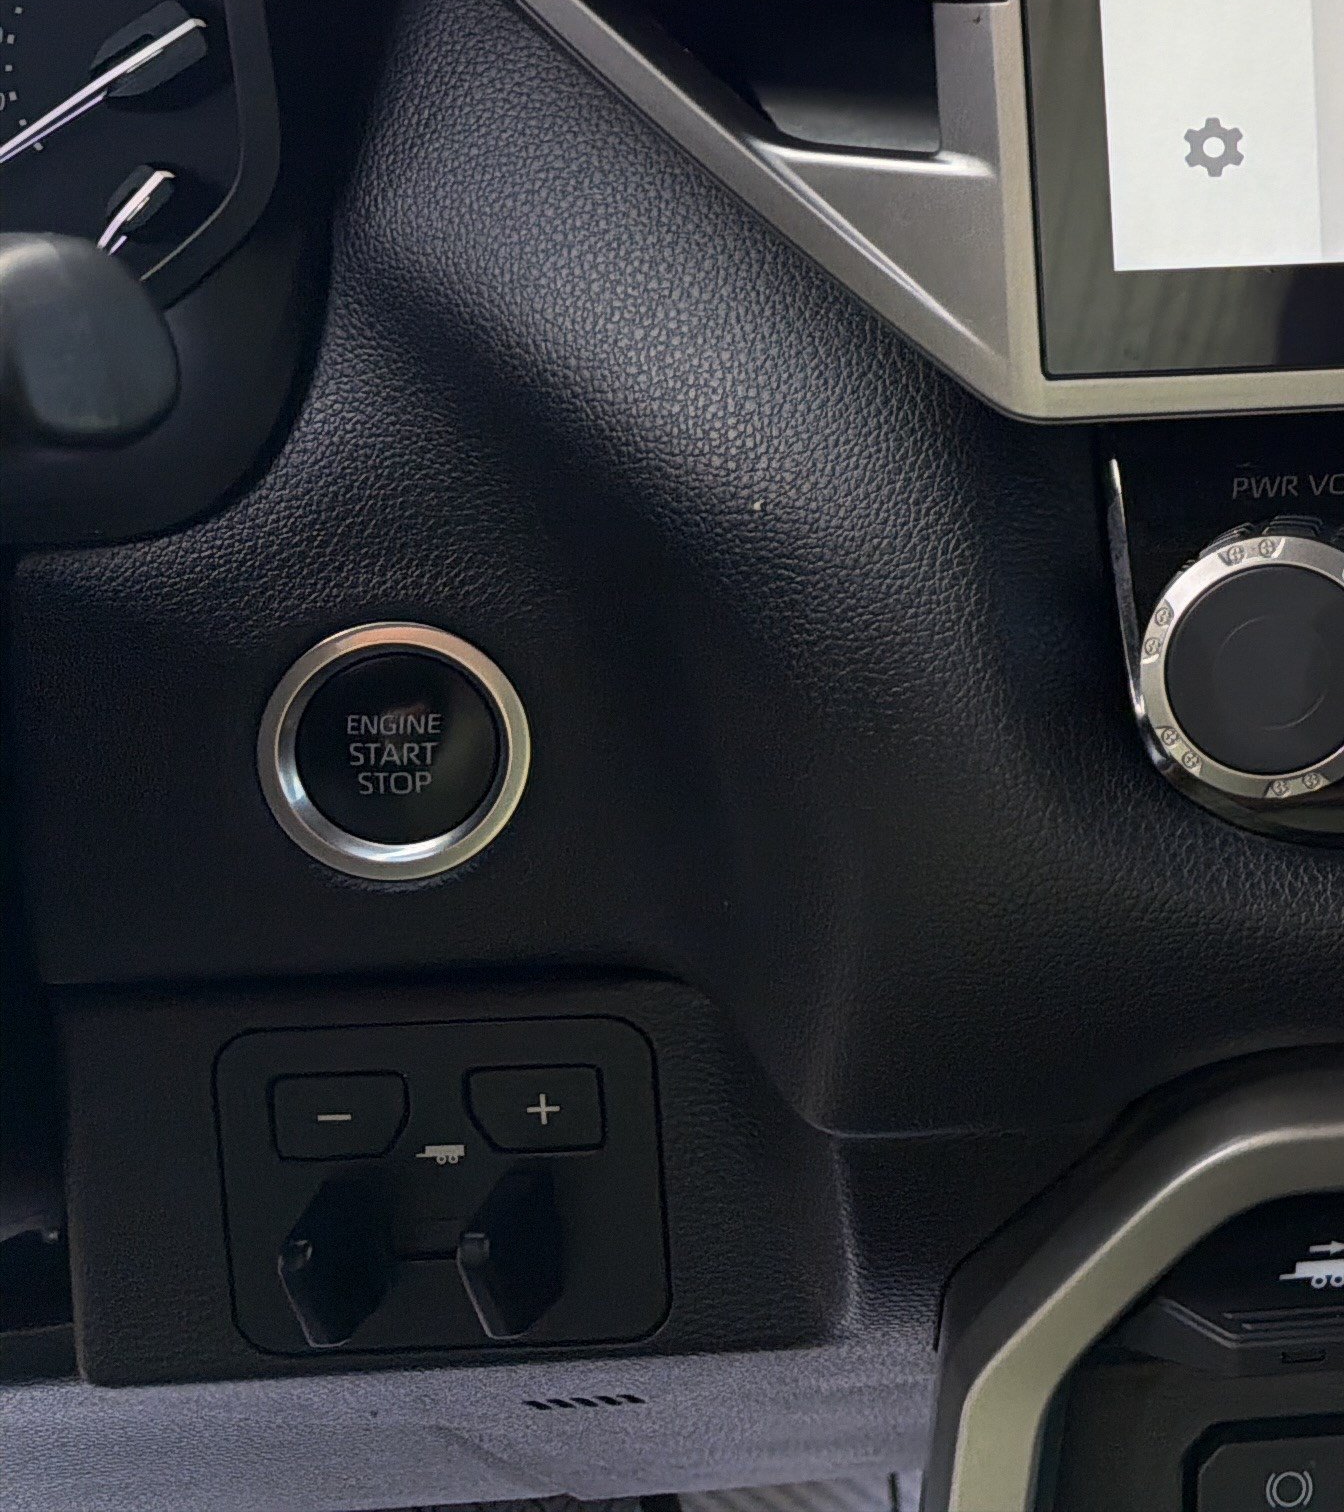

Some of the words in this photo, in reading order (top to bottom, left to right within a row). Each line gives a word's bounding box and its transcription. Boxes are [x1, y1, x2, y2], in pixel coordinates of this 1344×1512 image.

[1232, 475, 1300, 500] PWR
[346, 713, 443, 735] ENGINE
[348, 741, 441, 767] START
[357, 771, 433, 795] STOP
